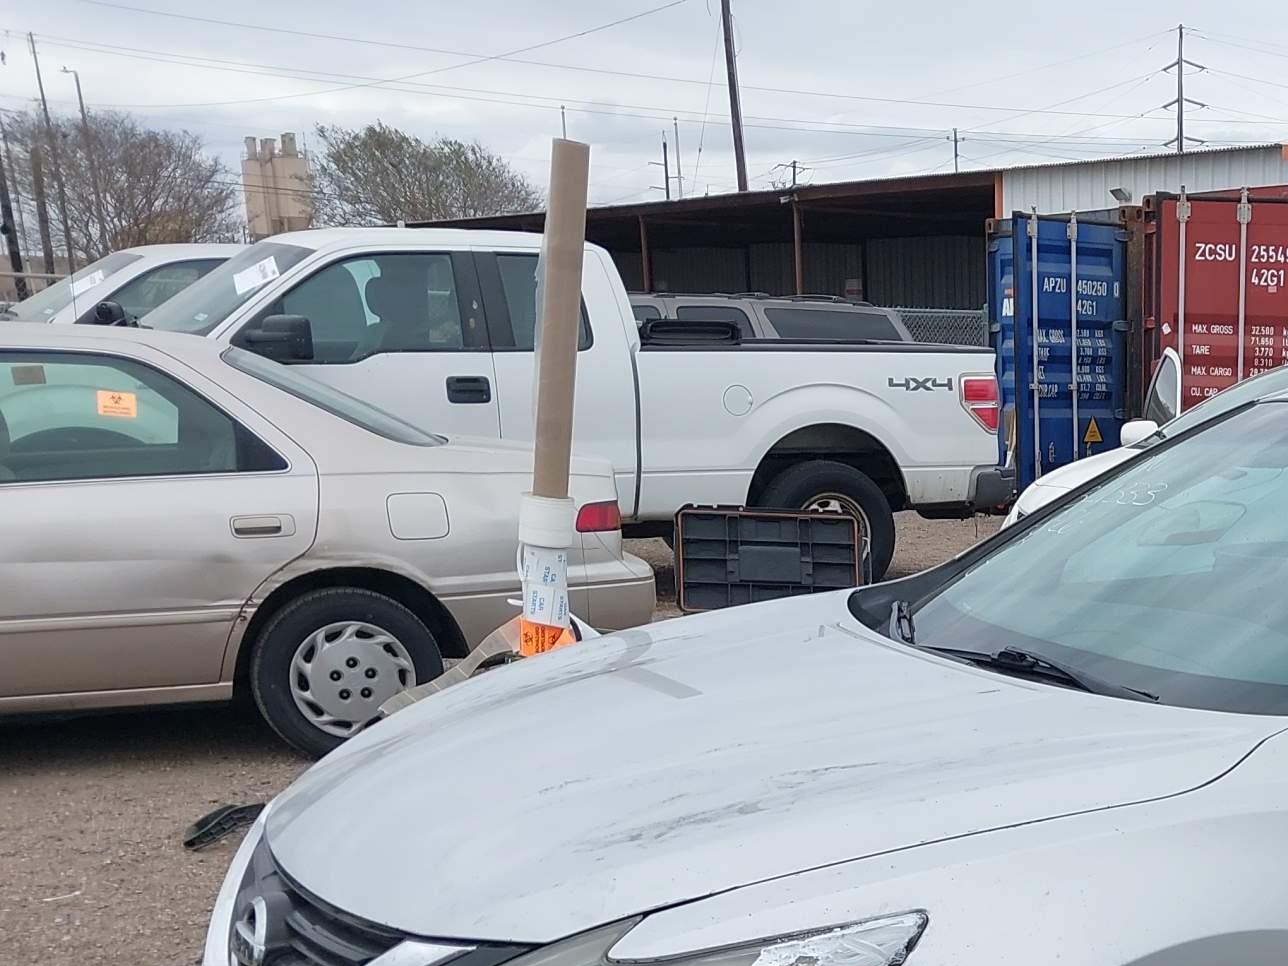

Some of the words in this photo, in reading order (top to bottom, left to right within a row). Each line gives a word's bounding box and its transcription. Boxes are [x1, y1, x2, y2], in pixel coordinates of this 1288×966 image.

[1195, 243, 1236, 261] ZCSU
[1251, 268, 1285, 286] 42G1
[1043, 277, 1067, 293] APZU
[1077, 280, 1107, 297] 450250
[1077, 299, 1097, 315] 42G1
[1210, 325, 1233, 335] GROSS
[1192, 345, 1210, 355] TARE
[1209, 367, 1232, 377] CARGO
[887, 377, 954, 392] 4X4
